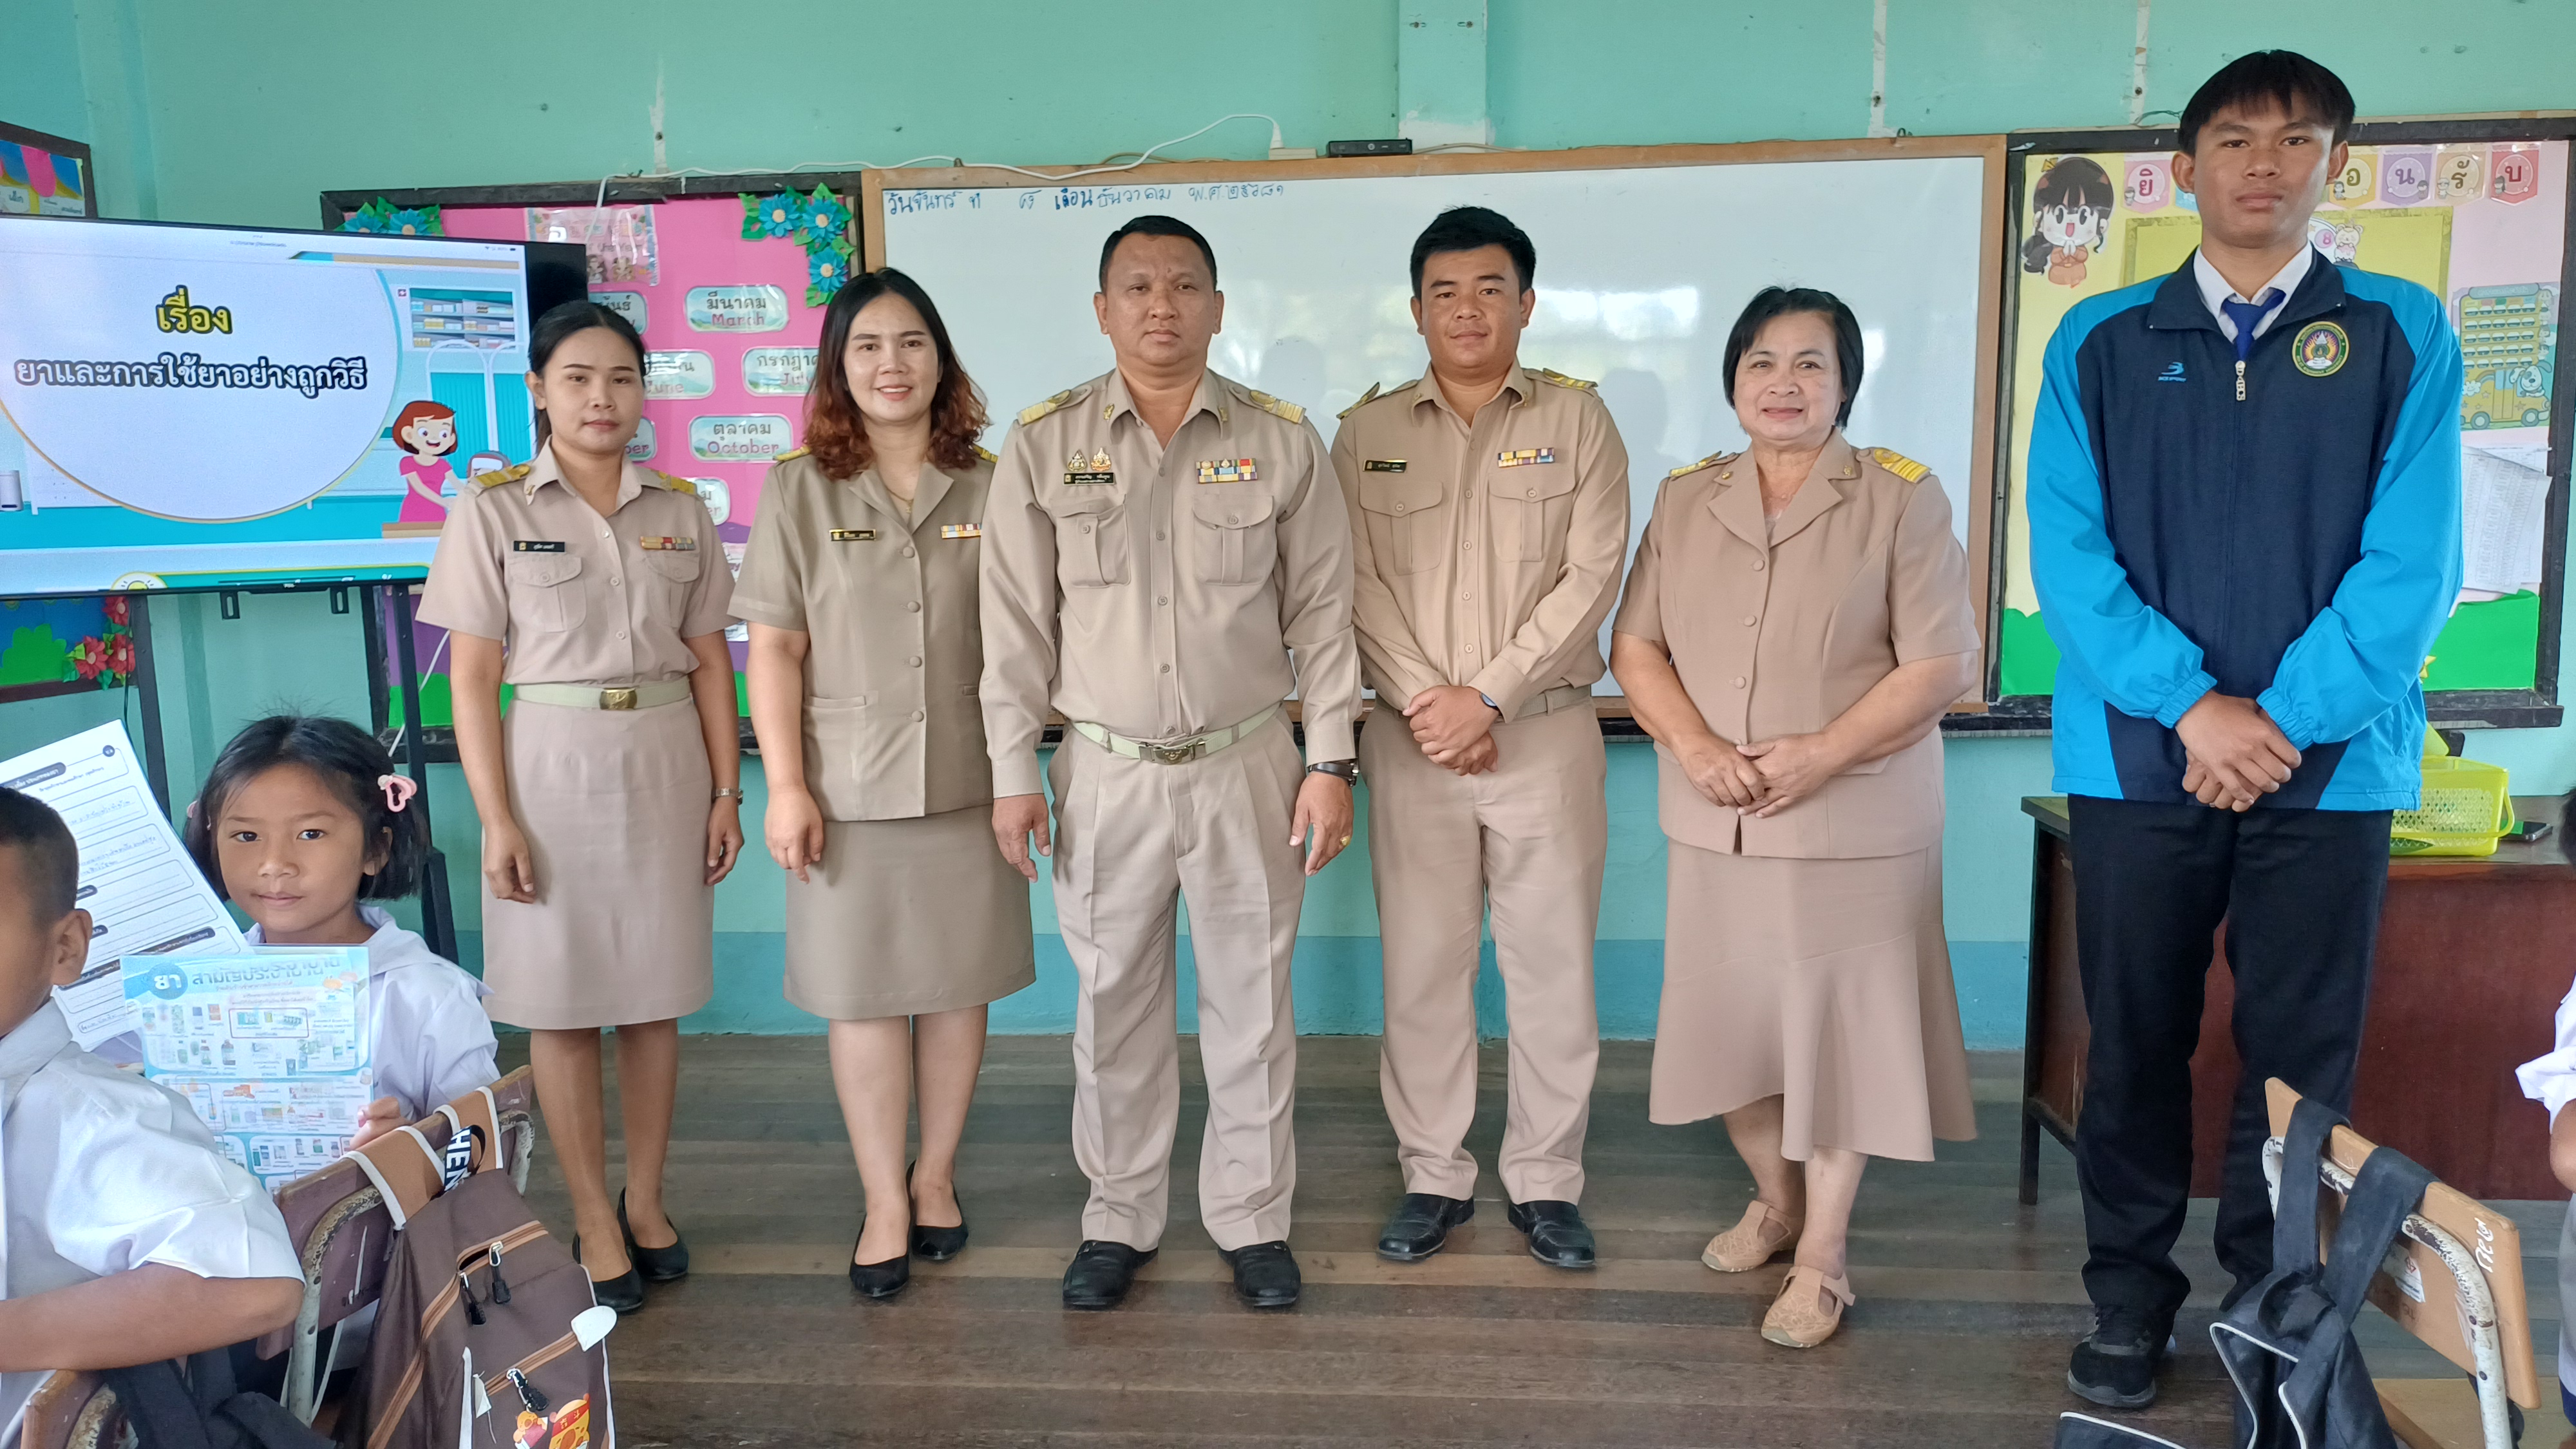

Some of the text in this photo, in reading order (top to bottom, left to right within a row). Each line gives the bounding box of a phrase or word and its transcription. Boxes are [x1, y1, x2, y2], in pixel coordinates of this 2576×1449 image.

[1097, 187, 1171, 207] ธันวาคม
[2323, 232, 2332, 245] 8
[707, 290, 766, 309] มีนาคม
[156, 286, 232, 334] เรื่อง
[712, 312, 765, 327] March
[15, 353, 366, 399] ยาและการใช้ยาอย่างถูกวิธี
[714, 423, 772, 440] ตุลาคม
[708, 439, 779, 455] October
